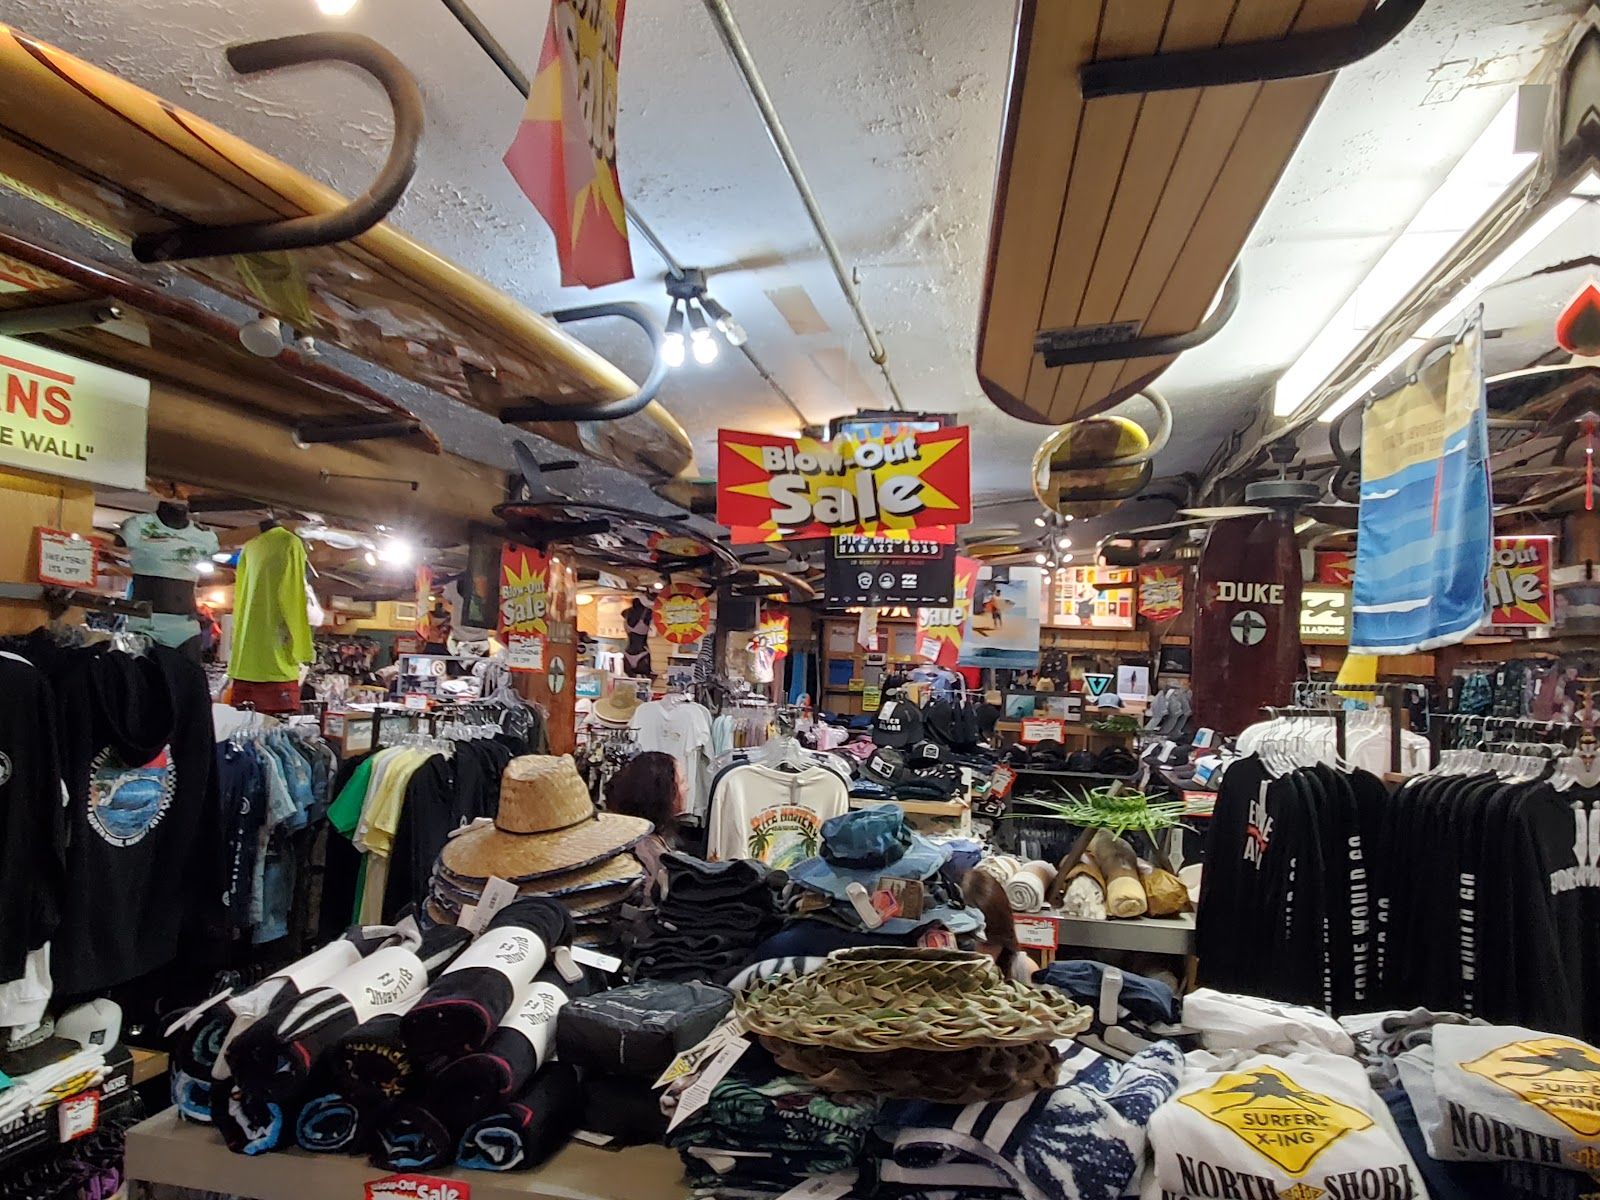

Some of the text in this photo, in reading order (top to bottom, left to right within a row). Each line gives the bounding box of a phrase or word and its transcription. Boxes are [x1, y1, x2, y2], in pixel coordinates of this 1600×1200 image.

[5, 372, 72, 426] NS
[20, 430, 94, 462] WALL"
[761, 435, 920, 476] Blow-Out
[767, 469, 926, 526] Sale
[903, 545, 939, 554] 2019
[1496, 546, 1541, 568] Out
[1216, 581, 1284, 604] DUKE
[503, 594, 547, 627] Sale
[1301, 626, 1345, 635] LLABONG
[1256, 1131, 1316, 1147] X-ING
[1448, 1100, 1562, 1164] NORTH
[1175, 1152, 1281, 1200] NORTH
